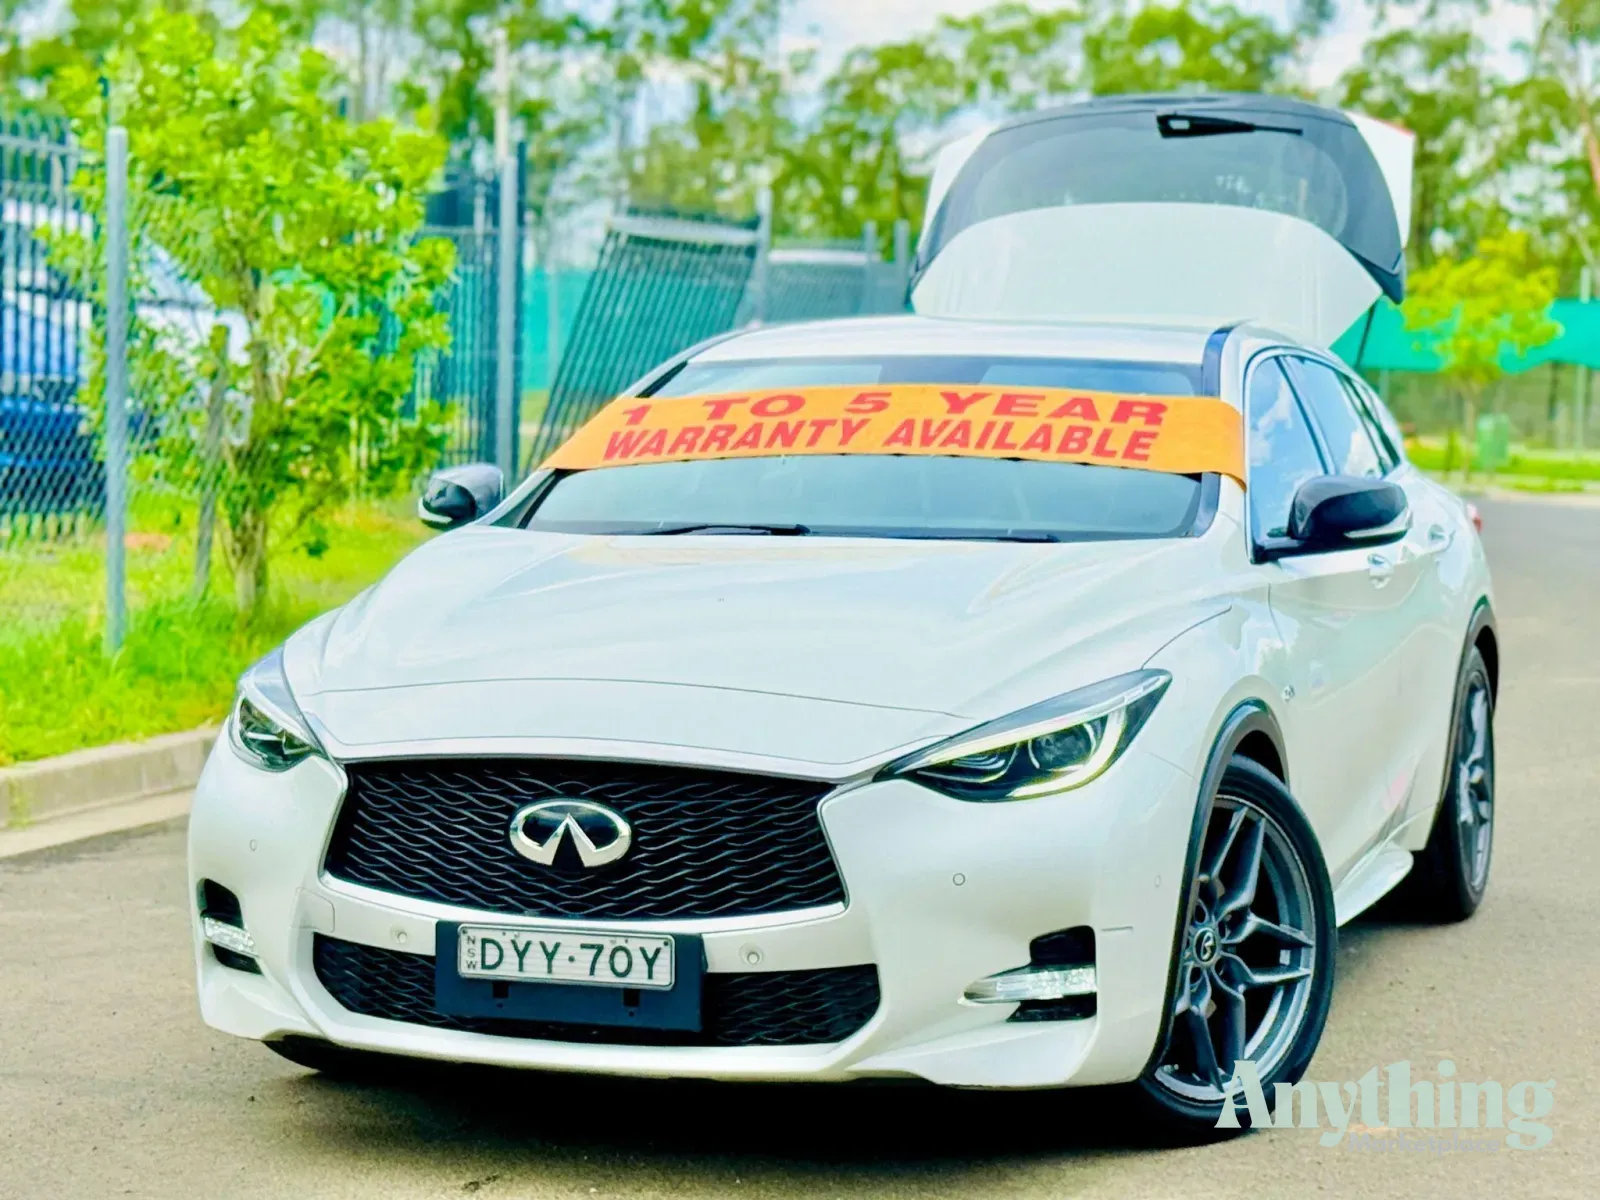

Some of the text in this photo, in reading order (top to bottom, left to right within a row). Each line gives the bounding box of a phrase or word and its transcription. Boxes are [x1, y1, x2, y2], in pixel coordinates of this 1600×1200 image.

[622, 392, 1168, 426] 1 TO 5 YEAR
[603, 417, 1160, 462] WARRANTY AVAILABLE
